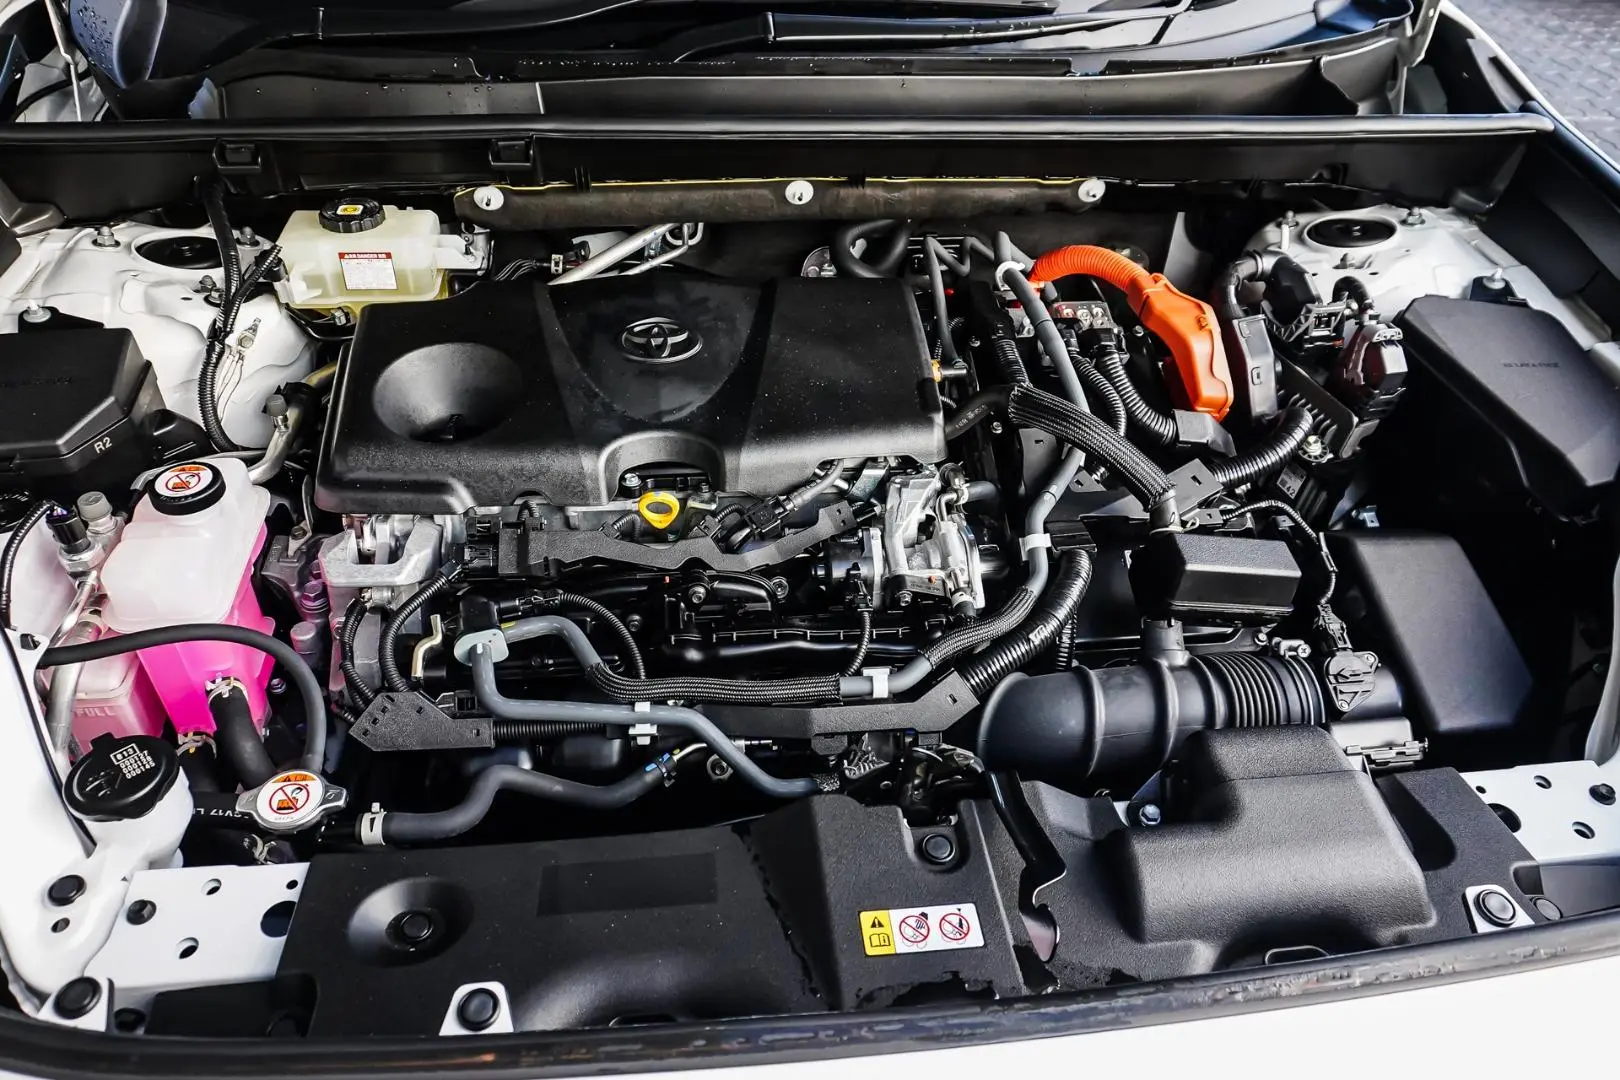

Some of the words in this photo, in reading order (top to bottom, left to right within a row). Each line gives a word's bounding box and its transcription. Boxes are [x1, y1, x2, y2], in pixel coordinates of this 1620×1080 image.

[94, 436, 113, 454] R2
[120, 750, 149, 769] 000127
[125, 761, 156, 780] 000145
